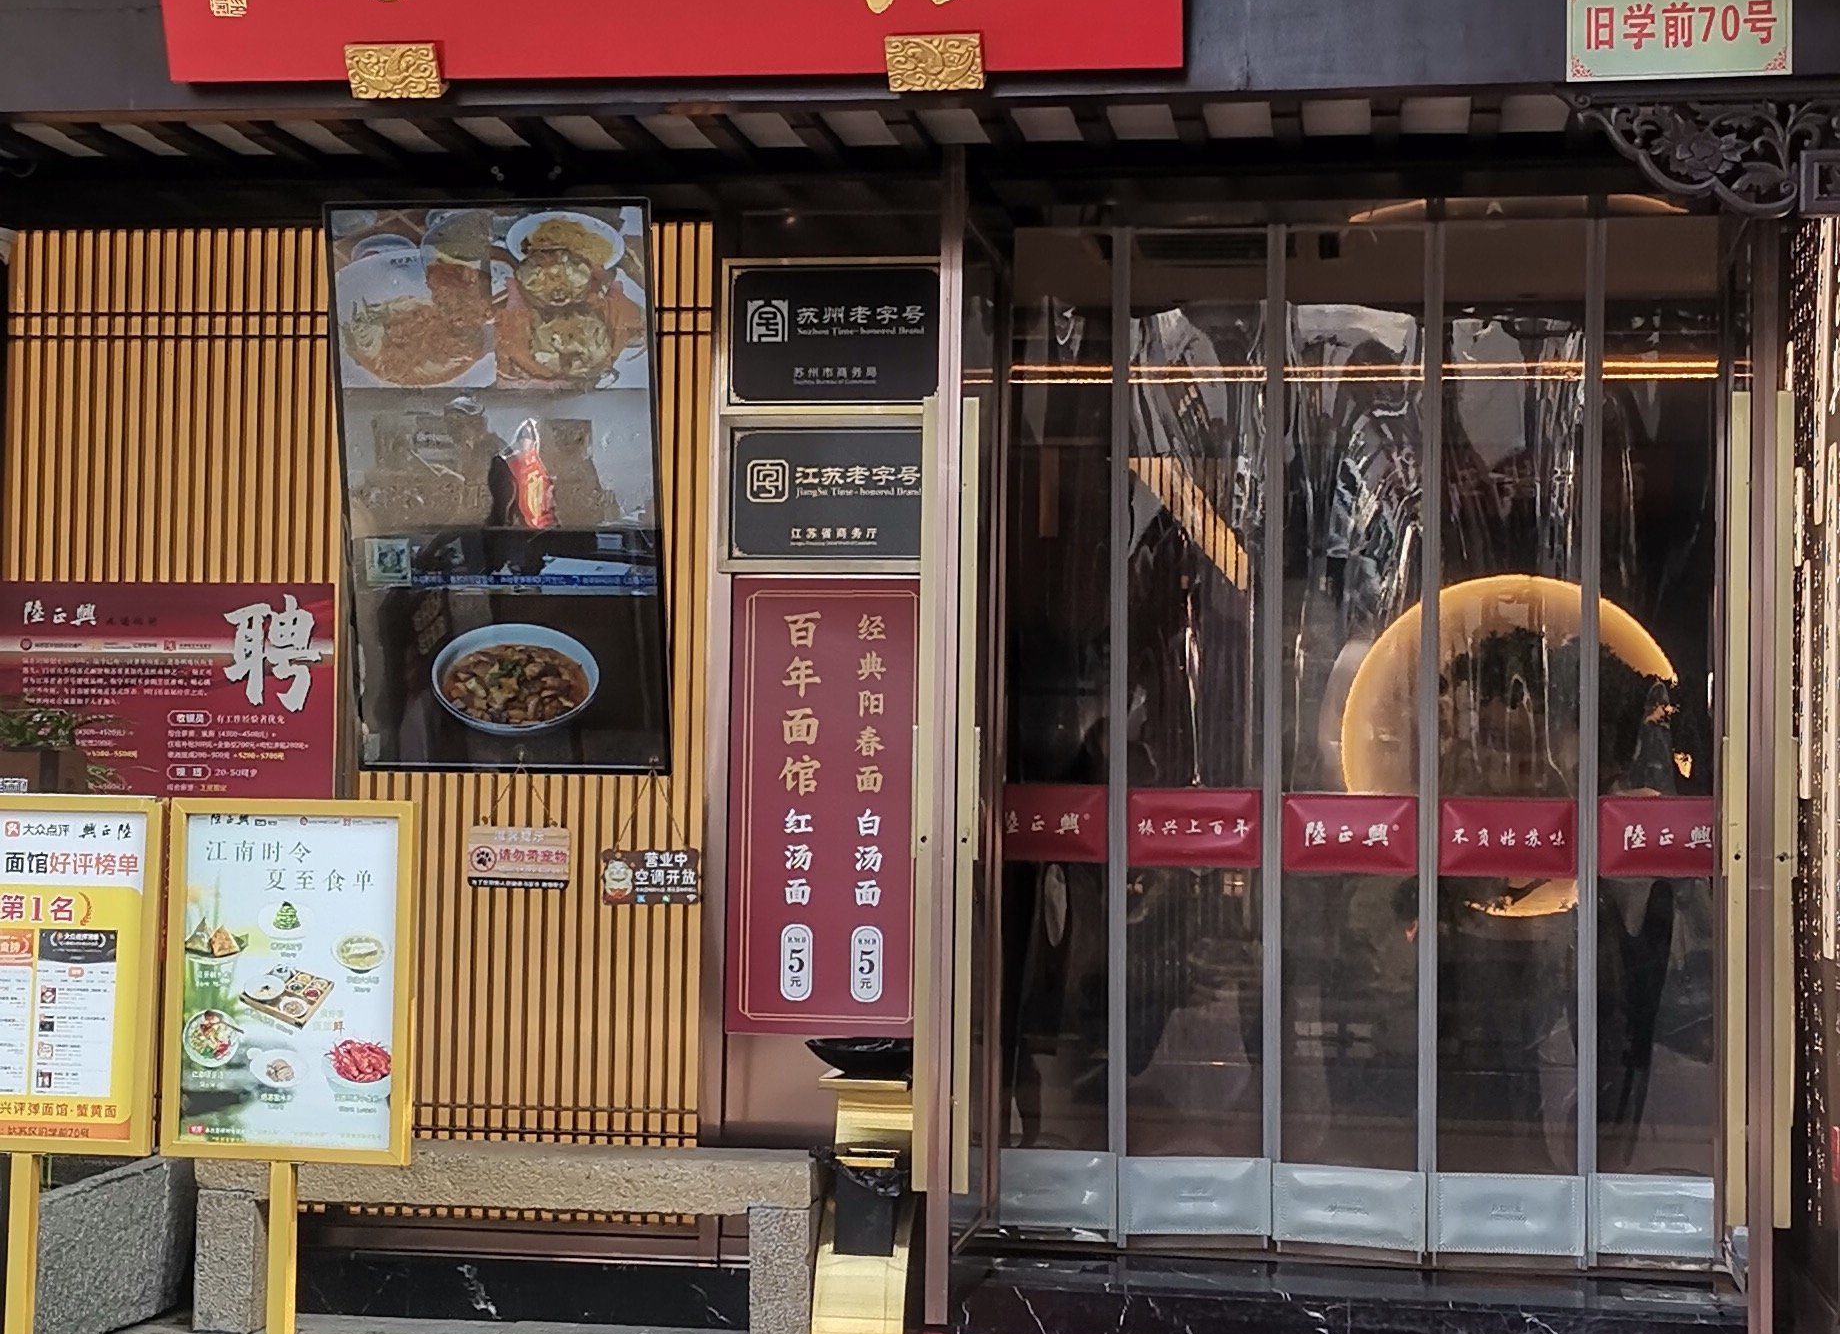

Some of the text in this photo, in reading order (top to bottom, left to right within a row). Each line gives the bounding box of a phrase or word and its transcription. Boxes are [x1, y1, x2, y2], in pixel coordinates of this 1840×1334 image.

[1585, 0, 1778, 50] 旧学前70号
[796, 305, 925, 325] 苏州老字号
[793, 366, 877, 379] 苏州市商务局
[795, 466, 921, 486] 江苏老字号
[790, 527, 878, 540] 江苏省商务厅
[23, 599, 97, 627] 陸正興
[223, 593, 322, 713] 聘
[778, 611, 822, 797] 百年面馆
[853, 613, 887, 794] 经典阳春面
[22, 823, 71, 837] 大众点评
[1304, 820, 1390, 848] 陸正興
[1451, 827, 1566, 848] 不负姑苏味
[1623, 824, 1714, 850] 陸正興
[206, 839, 312, 863] 江南时令
[644, 851, 688, 868] 营业中
[783, 807, 814, 907] 红汤面
[853, 808, 883, 909] 白汤面
[4, 851, 140, 877] 面馆好评榜单
[263, 867, 375, 893] 夏至食单
[634, 868, 697, 886] 空调开放
[0, 894, 75, 922] 第1名
[788, 948, 805, 973] 5
[858, 950, 875, 975] 5
[790, 975, 802, 988] 元
[859, 977, 873, 989] 元
